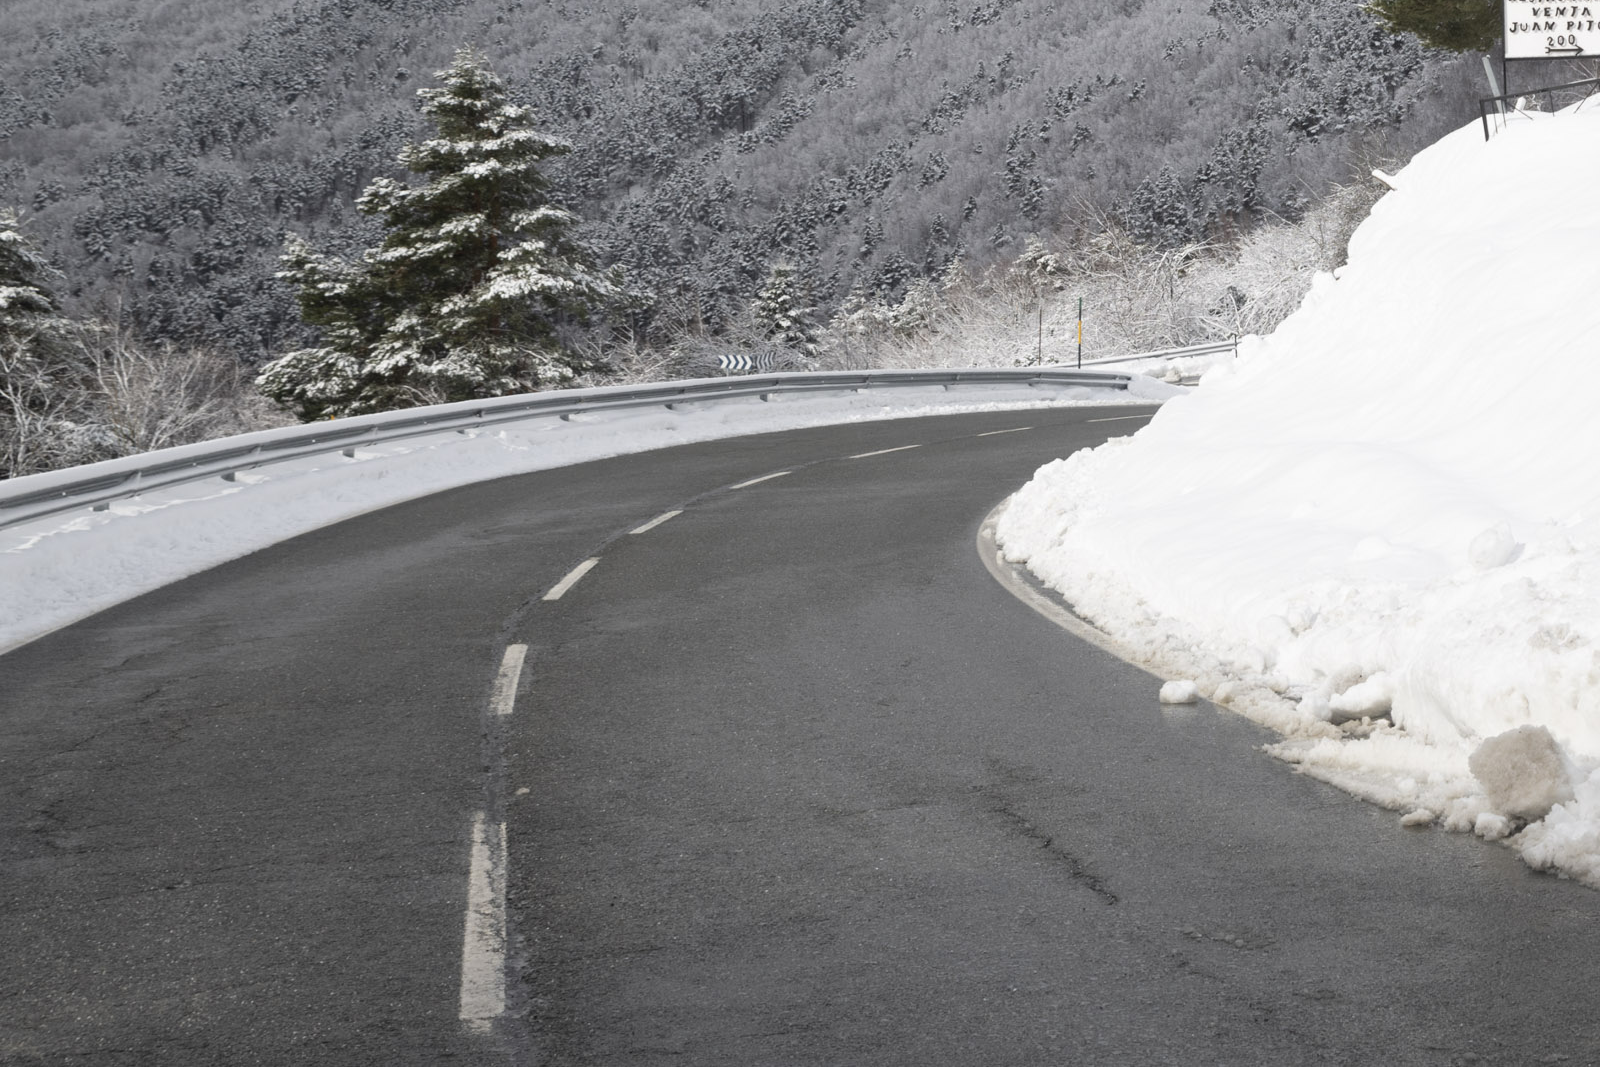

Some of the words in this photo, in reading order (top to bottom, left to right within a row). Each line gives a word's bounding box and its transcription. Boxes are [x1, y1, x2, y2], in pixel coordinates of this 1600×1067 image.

[1532, 5, 1591, 17] VENTA
[1509, 21, 1555, 33] JUAN
[1547, 34, 1576, 46] 200
